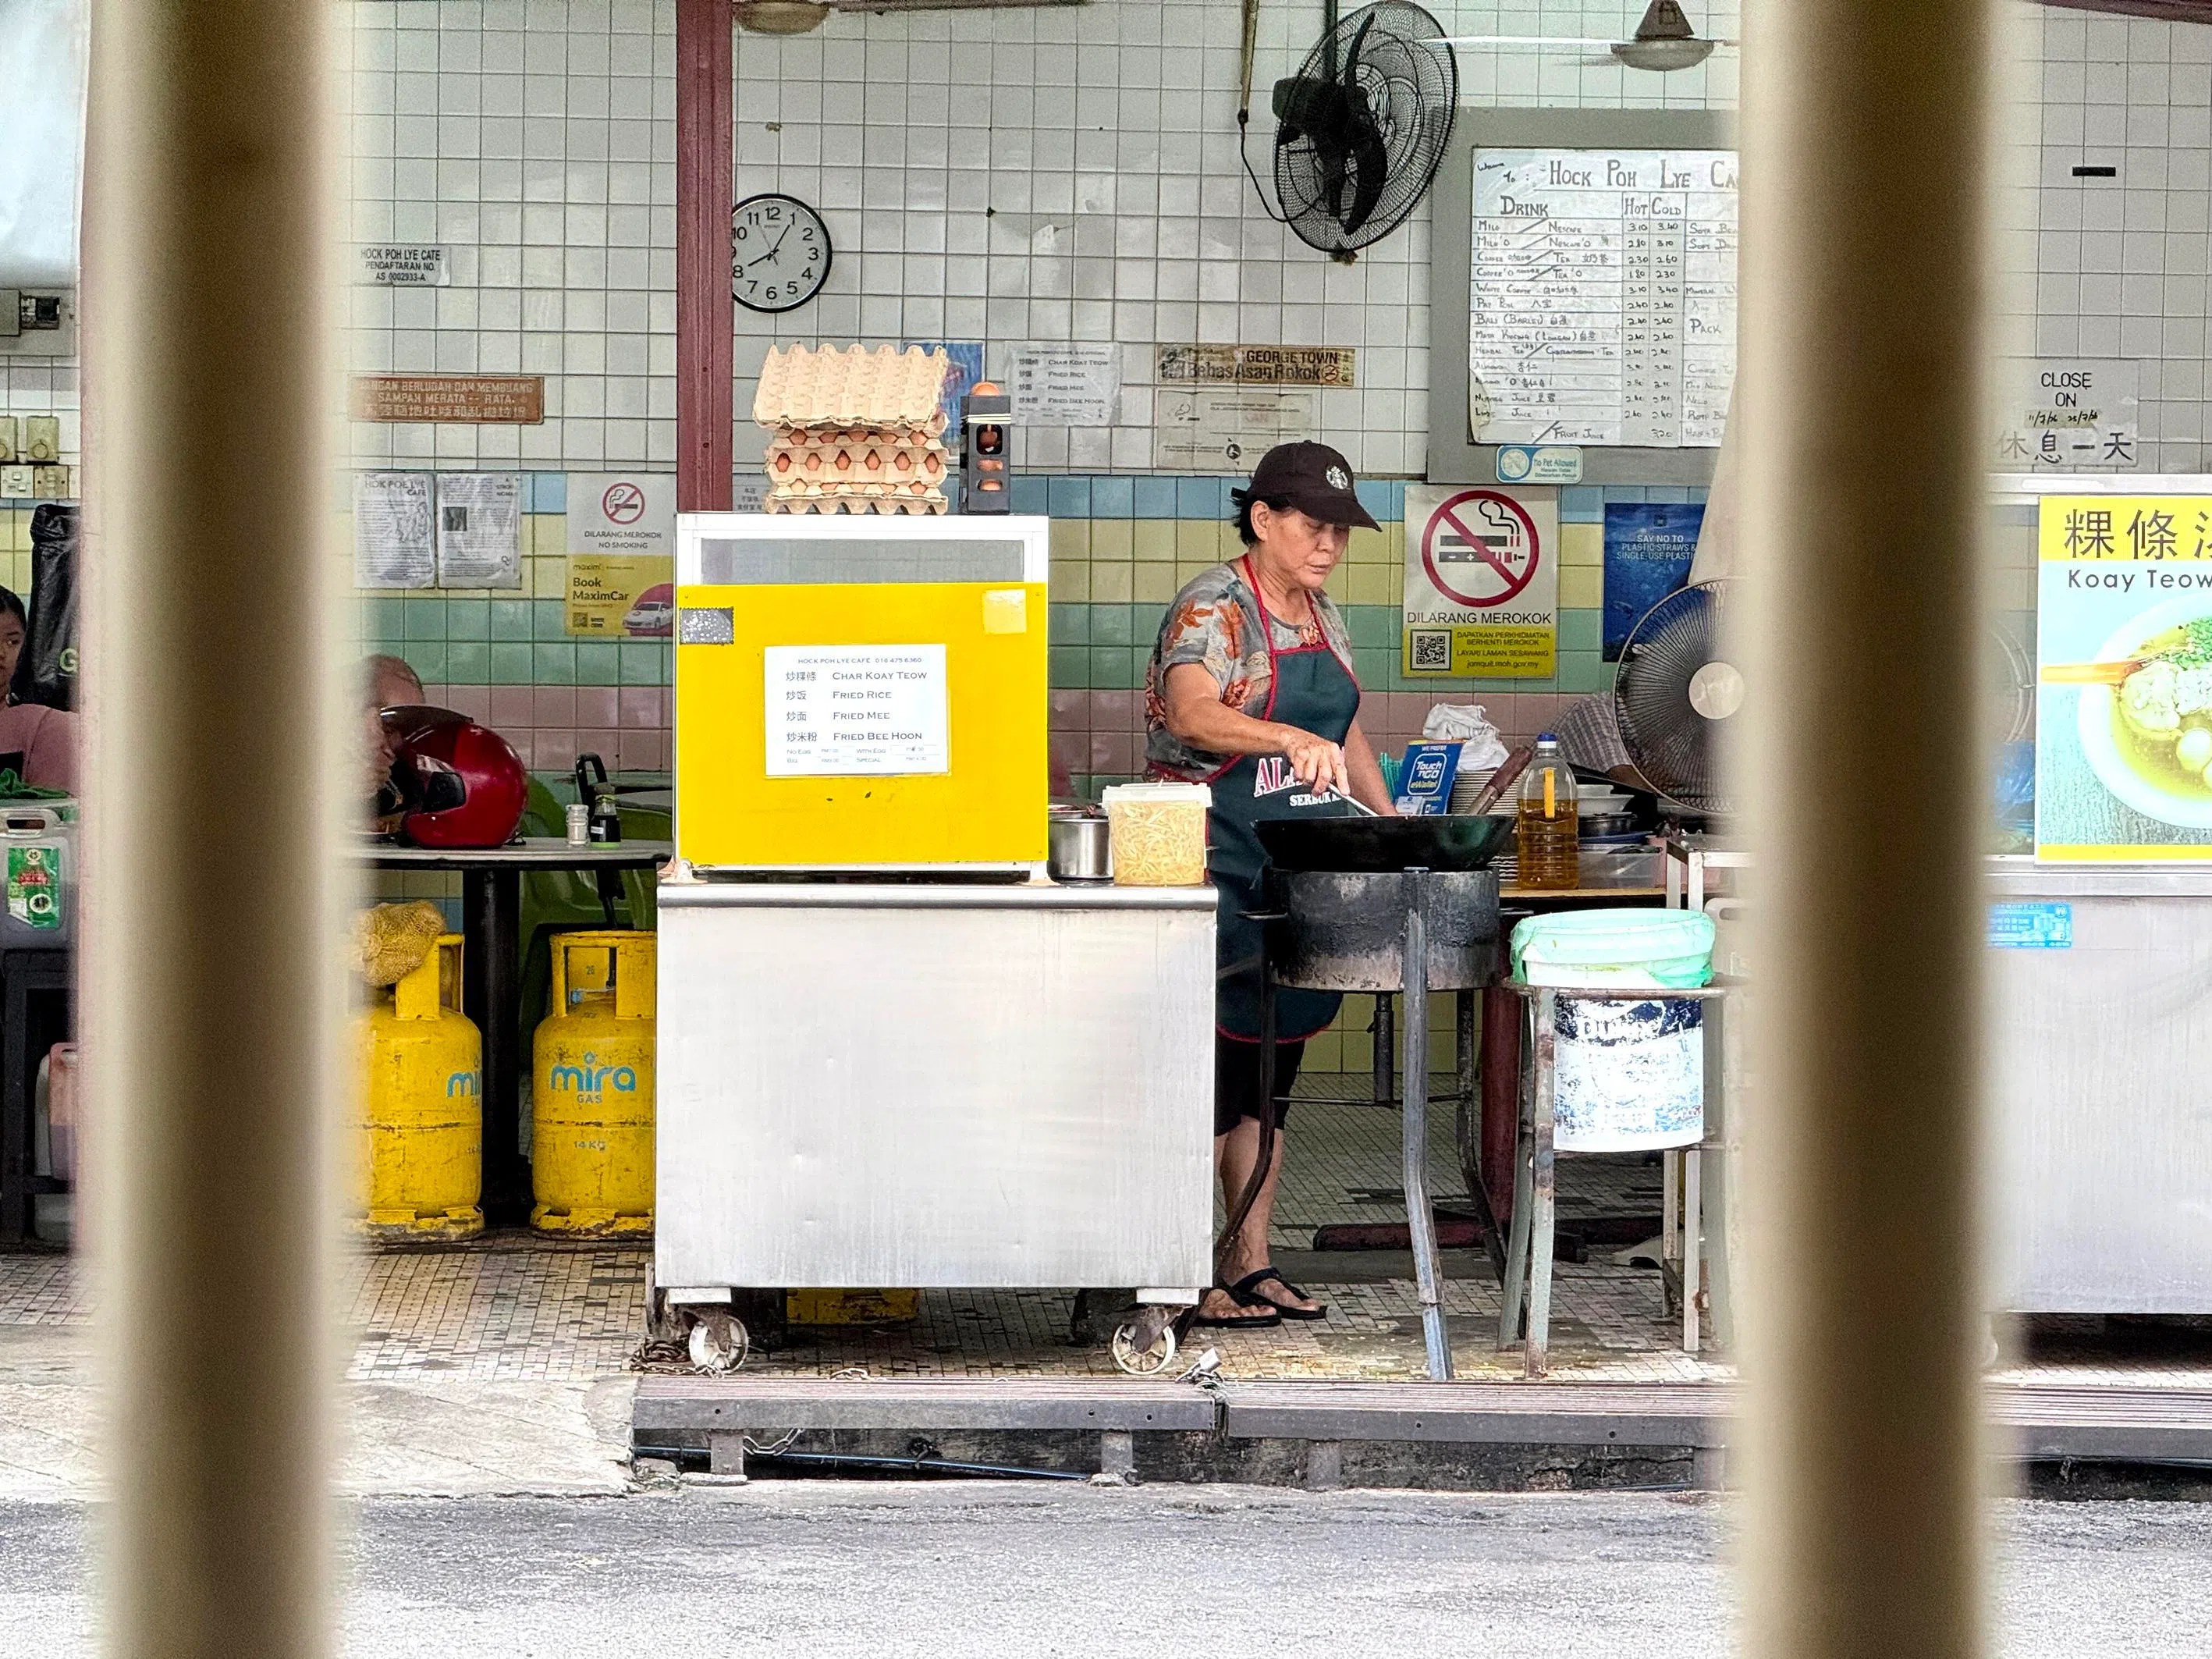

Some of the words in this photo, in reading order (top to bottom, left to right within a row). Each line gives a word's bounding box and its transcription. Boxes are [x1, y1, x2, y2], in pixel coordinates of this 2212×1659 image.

[1550, 160, 1592, 187] HOCK
[1607, 159, 1637, 187] POH
[1660, 159, 1691, 188] LYE
[1710, 160, 1737, 188] CA
[1500, 195, 1549, 216] DRINK
[1624, 197, 1648, 215] HOT
[1652, 197, 1681, 215] COLD
[747, 212, 759, 225] 11
[765, 207, 780, 220] 12
[790, 212, 796, 225] 1
[732, 227, 747, 240] 10
[802, 227, 813, 240] 2
[361, 249, 382, 259] HOCK
[385, 249, 402, 259] POH
[404, 250, 418, 260] LYE
[808, 247, 818, 260] 3
[365, 261, 421, 270] PENDAFTARAN
[733, 265, 744, 278] 8
[376, 272, 385, 281] AS
[801, 267, 813, 279] 4
[747, 281, 758, 293] 7
[766, 286, 777, 299] 6
[786, 282, 797, 294] 5
[1300, 351, 1338, 364] TOWN
[2041, 372, 2093, 388] CLOSE
[378, 393, 421, 403] SAMPAH
[425, 394, 466, 403] MERATA
[2055, 393, 2076, 407] ON
[1996, 429, 2134, 464] 休息一天
[1637, 535, 1653, 543] SAY
[1656, 535, 1670, 543] NO
[1671, 535, 1684, 543] TO
[1621, 542, 1655, 552] PLASTIC
[1656, 543, 1689, 552] STRAWS
[1617, 551, 1664, 560] SINGLE-USE
[573, 577, 602, 588] Book
[2068, 570, 2136, 593] Koay
[2147, 570, 2212, 588] Teow
[573, 591, 630, 601] MaximCar
[1408, 612, 1477, 623] DILARANG
[1482, 613, 1551, 624] MEROKOK
[786, 711, 807, 722] 炒面
[786, 732, 817, 742] 炒米粉
[1416, 760, 1443, 771] Touch
[549, 1051, 637, 1092] mira
[577, 1094, 603, 1104] GAS
